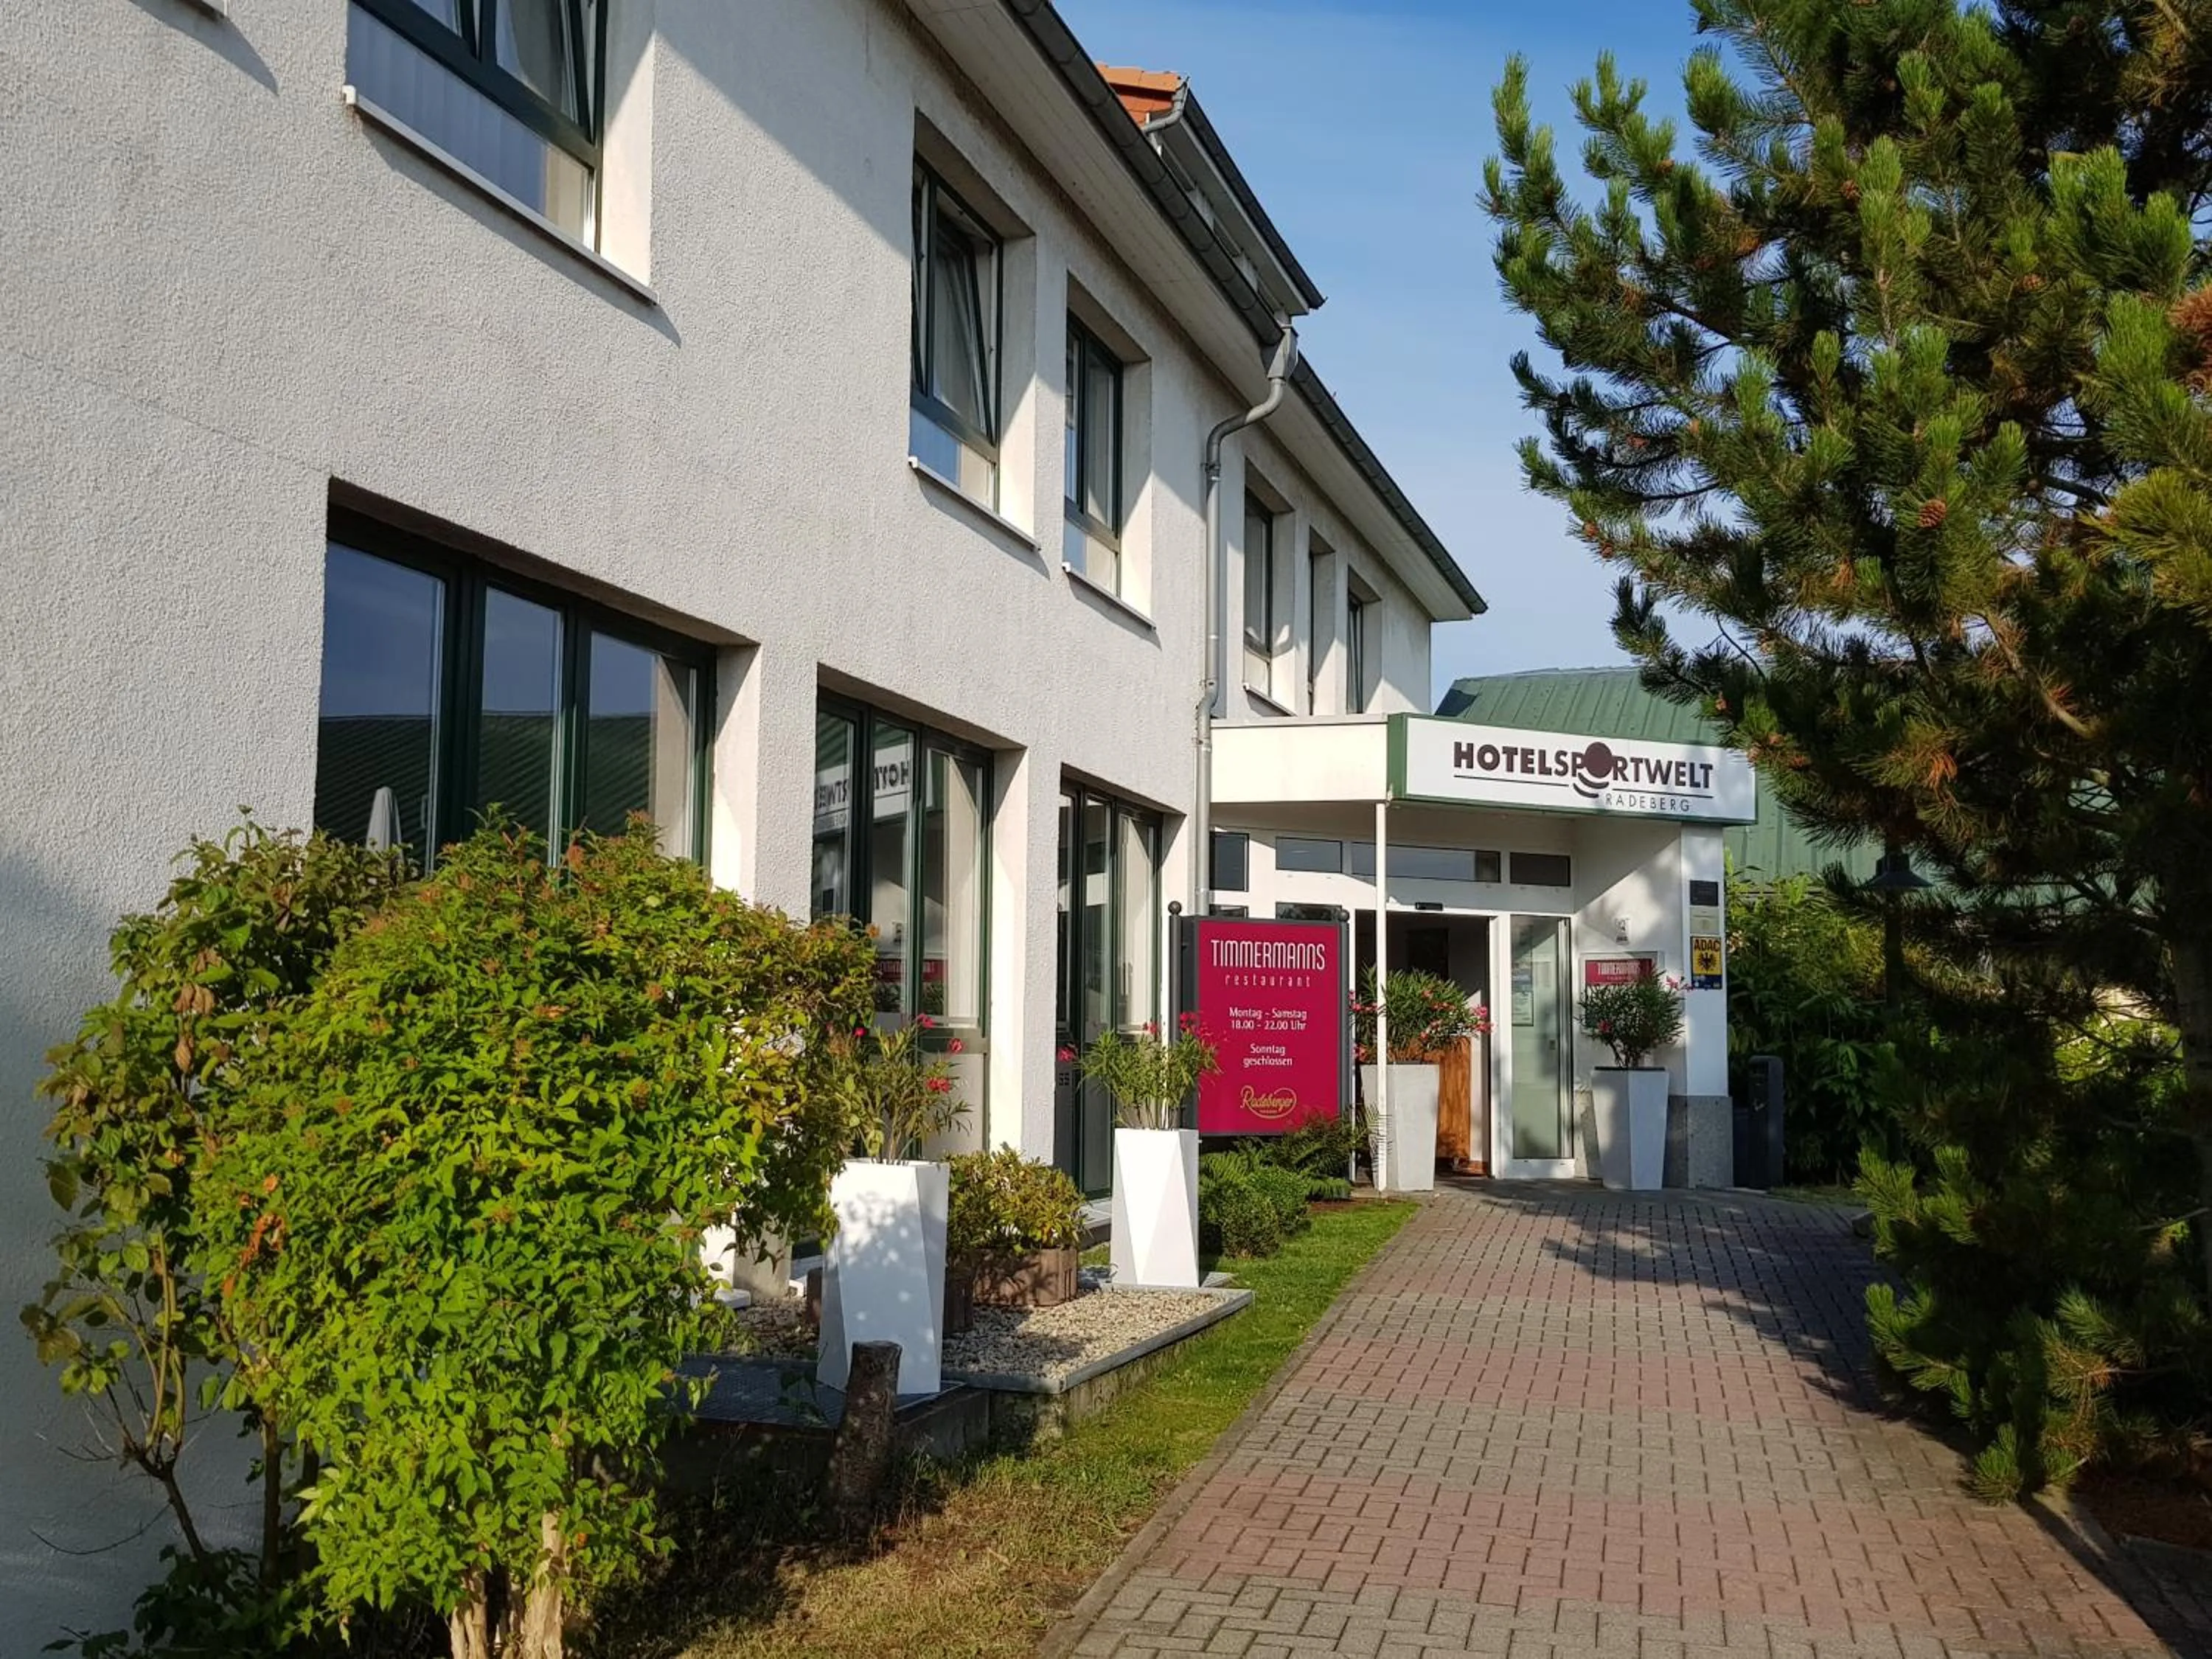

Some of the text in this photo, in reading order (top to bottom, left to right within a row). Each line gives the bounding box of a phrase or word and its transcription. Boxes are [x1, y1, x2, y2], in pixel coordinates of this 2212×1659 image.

[1605, 793, 1690, 812] RADEBERG
[1694, 939, 1720, 951] ADAC
[1210, 939, 1325, 970] TIMMERMANNS
[1225, 973, 1310, 987] restaurant
[1229, 1006, 1262, 1019] Montag
[1272, 1008, 1307, 1021] Samstag
[1231, 1020, 1254, 1030] 18.00
[1264, 1020, 1288, 1030] 22.00
[1290, 1020, 1307, 1030] Uhr
[1250, 1043, 1285, 1056] Sonntag
[1243, 1056, 1293, 1068] geschlossen
